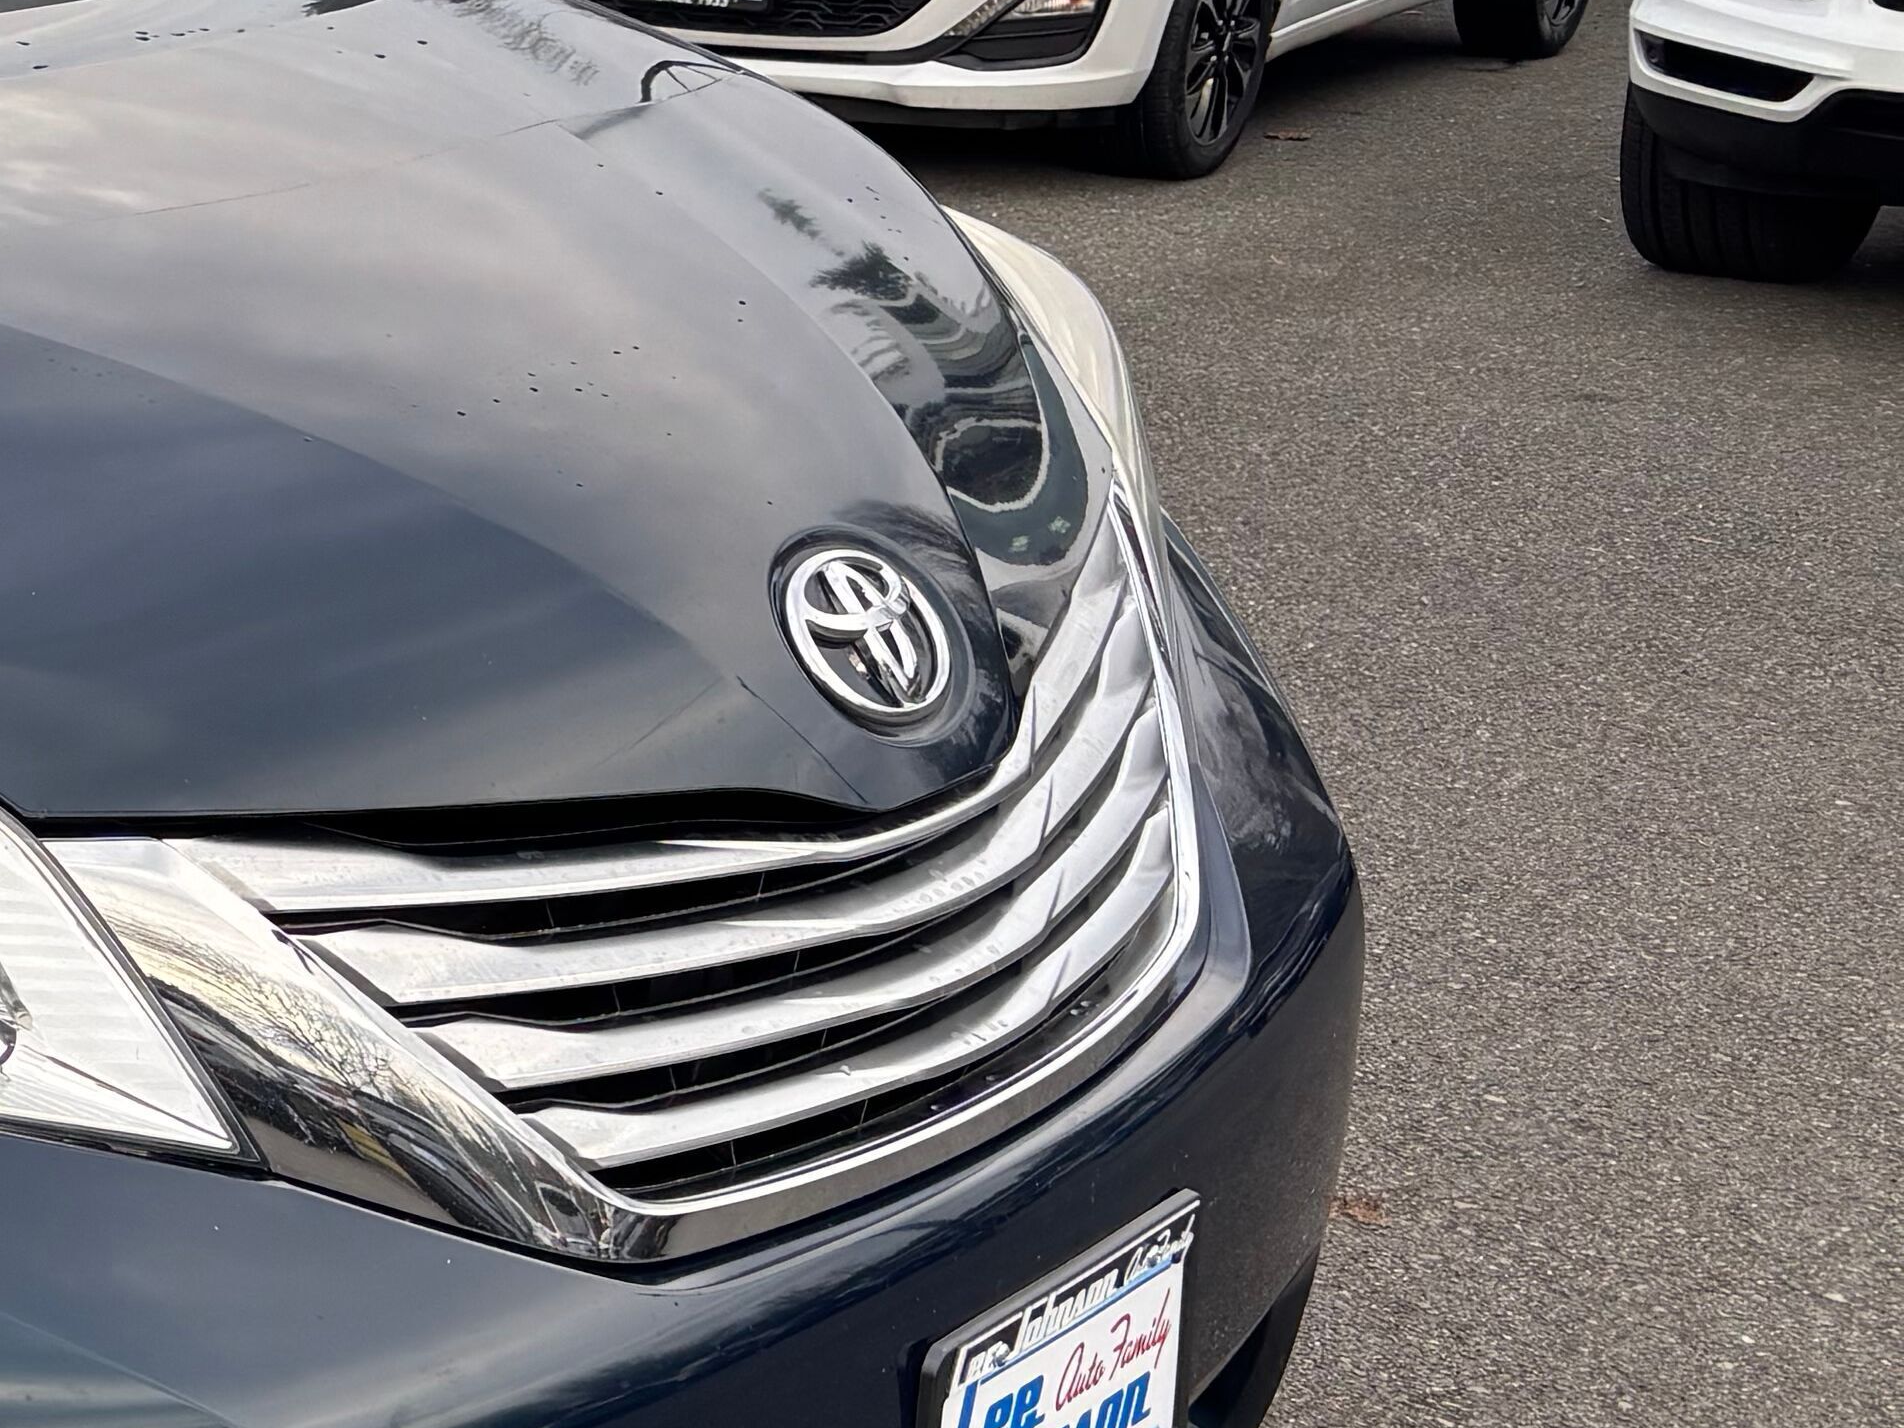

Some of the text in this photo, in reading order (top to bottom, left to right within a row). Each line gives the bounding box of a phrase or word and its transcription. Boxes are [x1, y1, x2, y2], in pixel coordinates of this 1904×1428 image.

[1008, 1268, 1120, 1357] Johnson
[1055, 1341, 1106, 1411] Auto
[1110, 1287, 1172, 1382] Family
